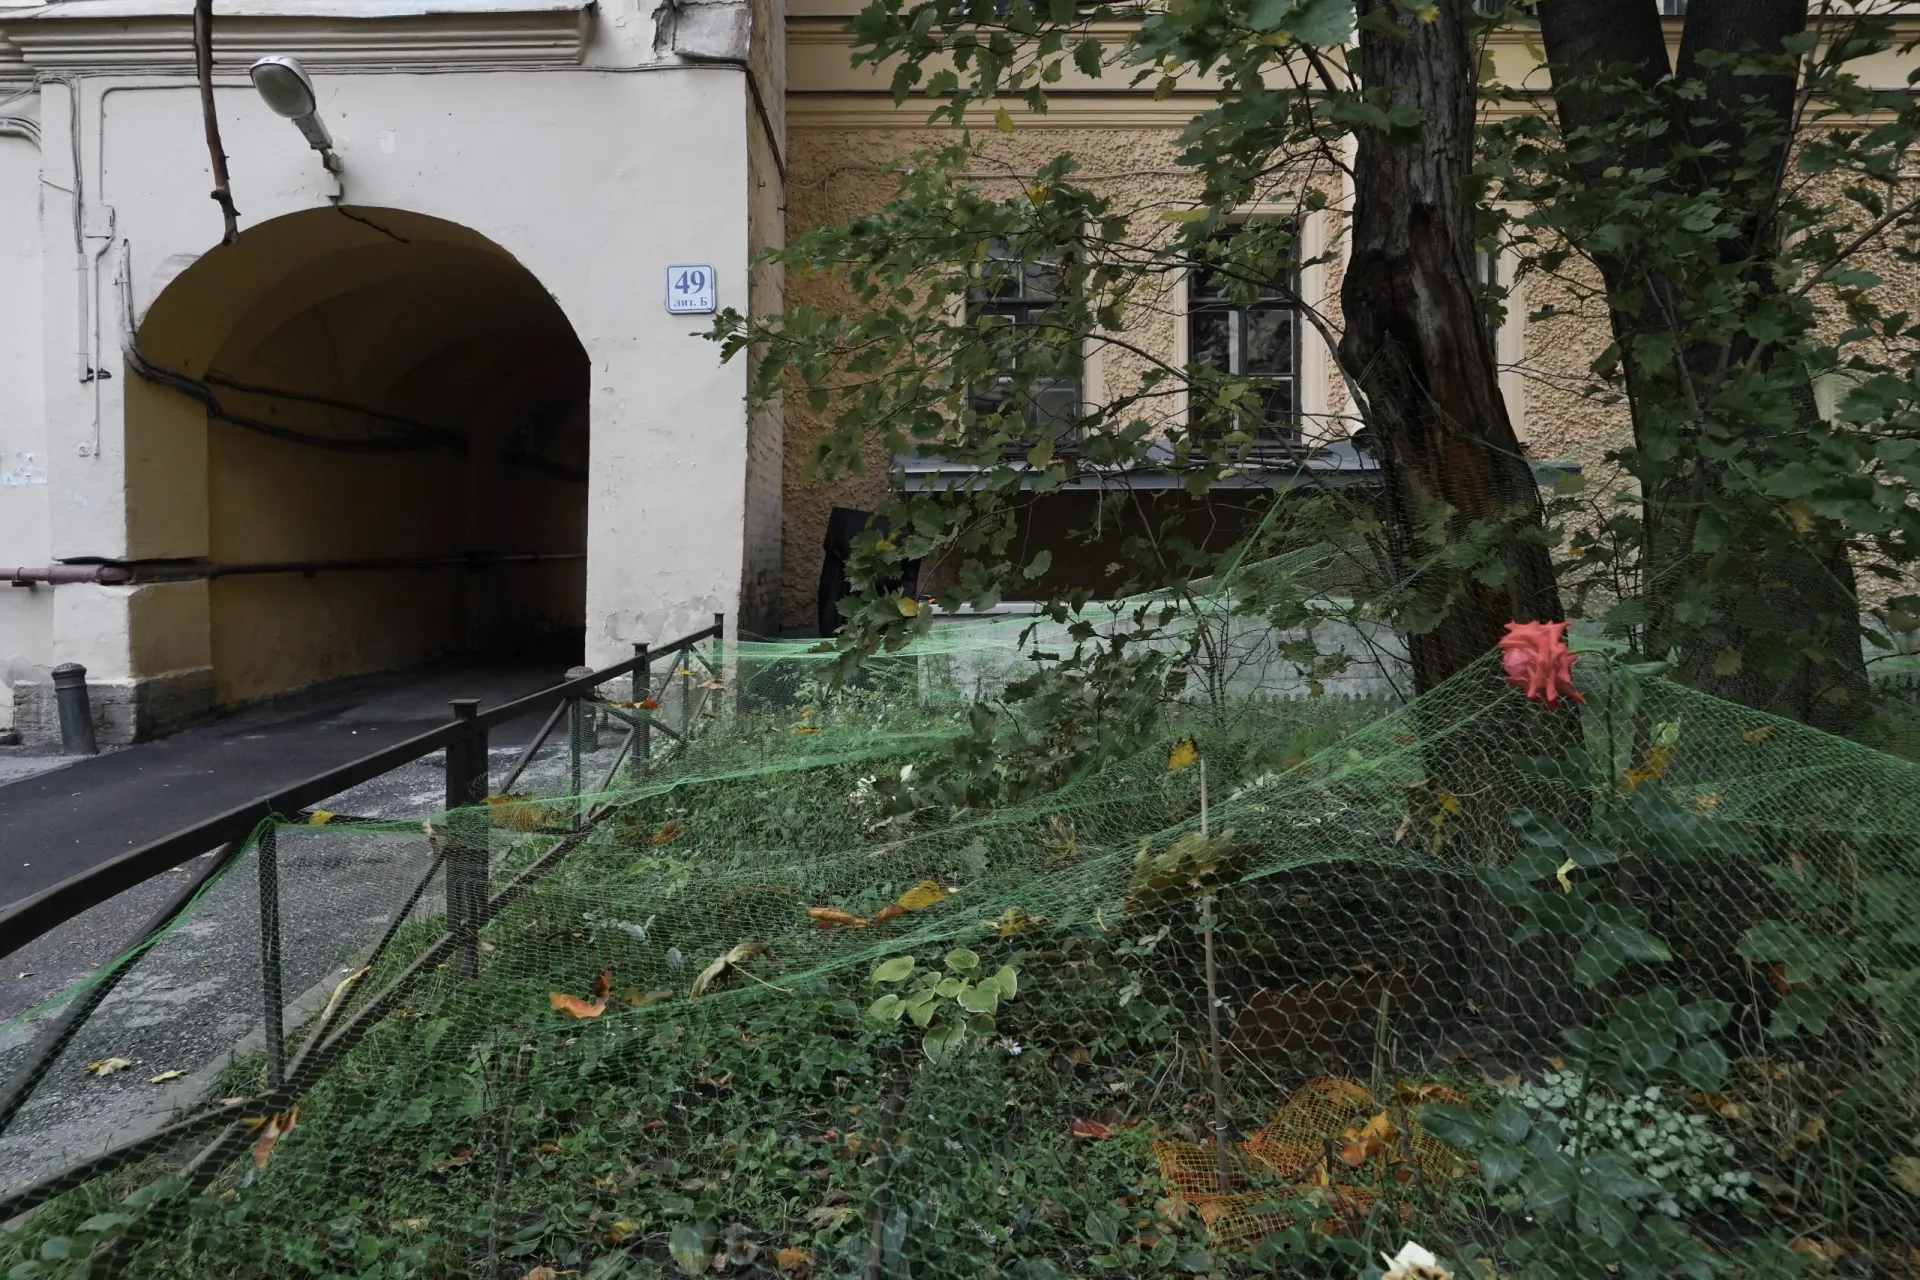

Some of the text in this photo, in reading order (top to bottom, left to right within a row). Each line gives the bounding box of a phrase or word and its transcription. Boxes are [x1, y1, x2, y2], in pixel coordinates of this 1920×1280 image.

[674, 270, 705, 295] 49
[673, 296, 708, 307] лит. Б
